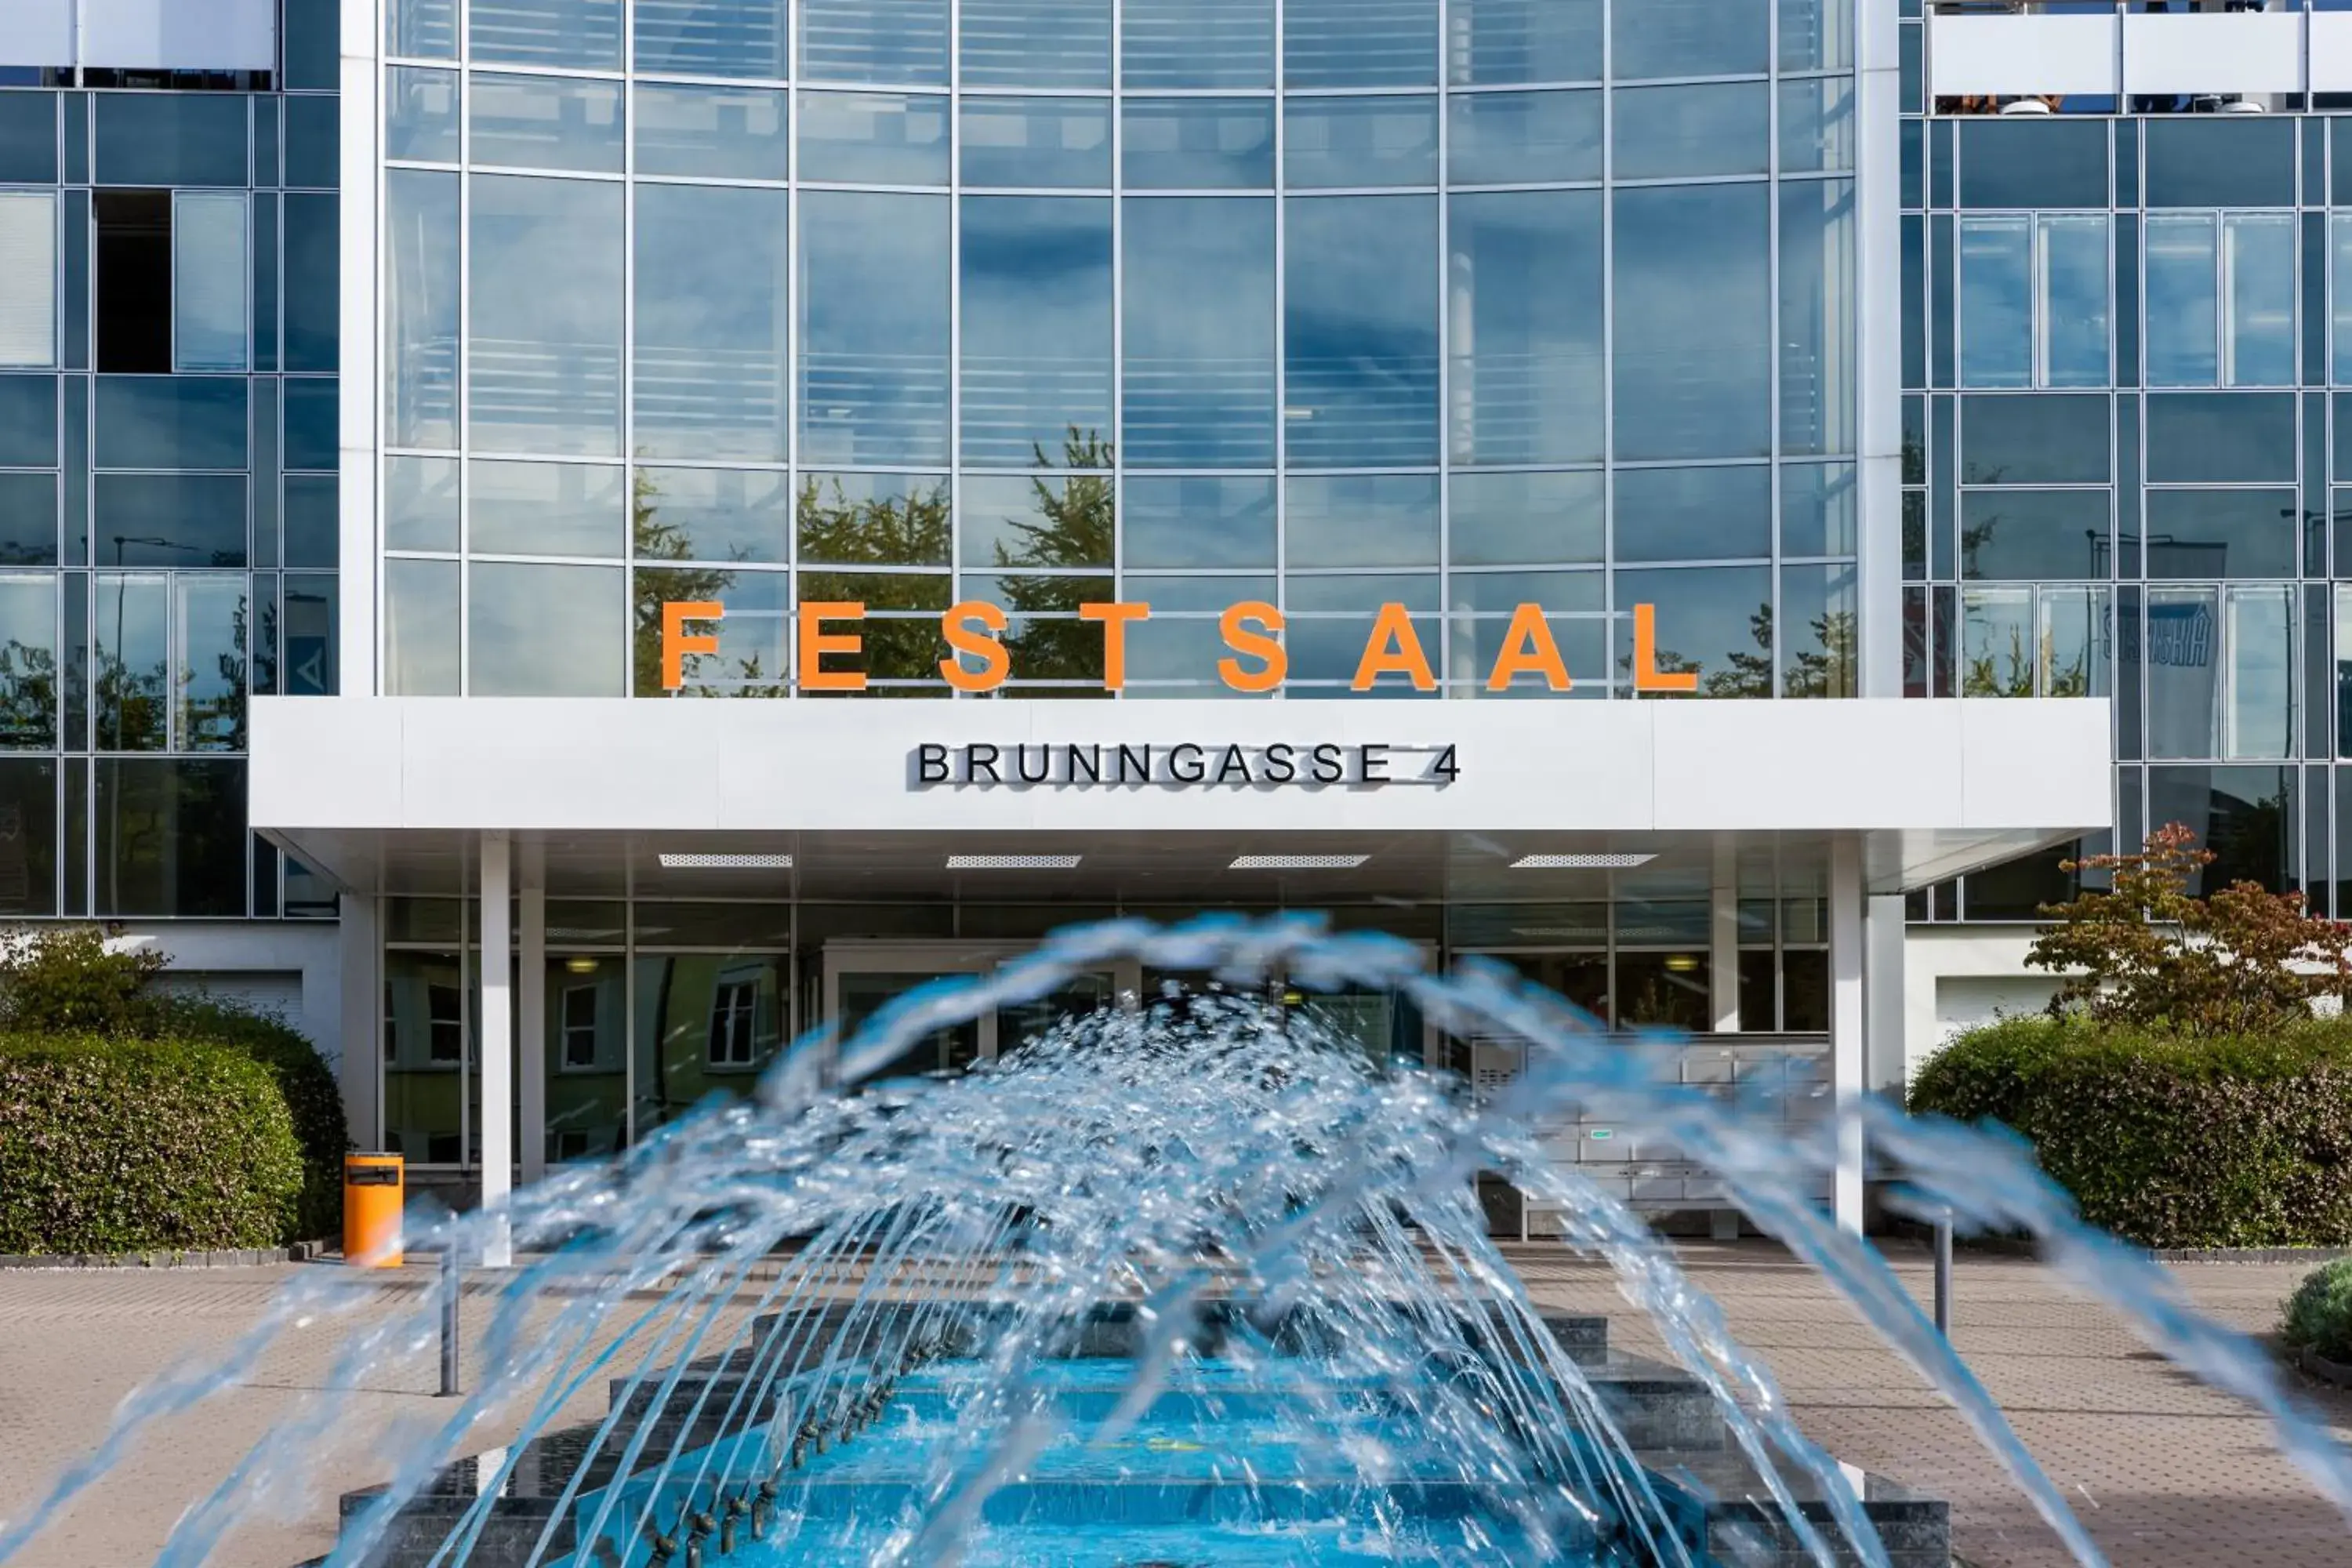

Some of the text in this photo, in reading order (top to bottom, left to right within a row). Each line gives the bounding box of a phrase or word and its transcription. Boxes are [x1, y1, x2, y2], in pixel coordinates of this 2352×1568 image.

[661, 601, 1697, 691] FESTSAAL
[919, 742, 1461, 783] BRUNNGASSE 4
